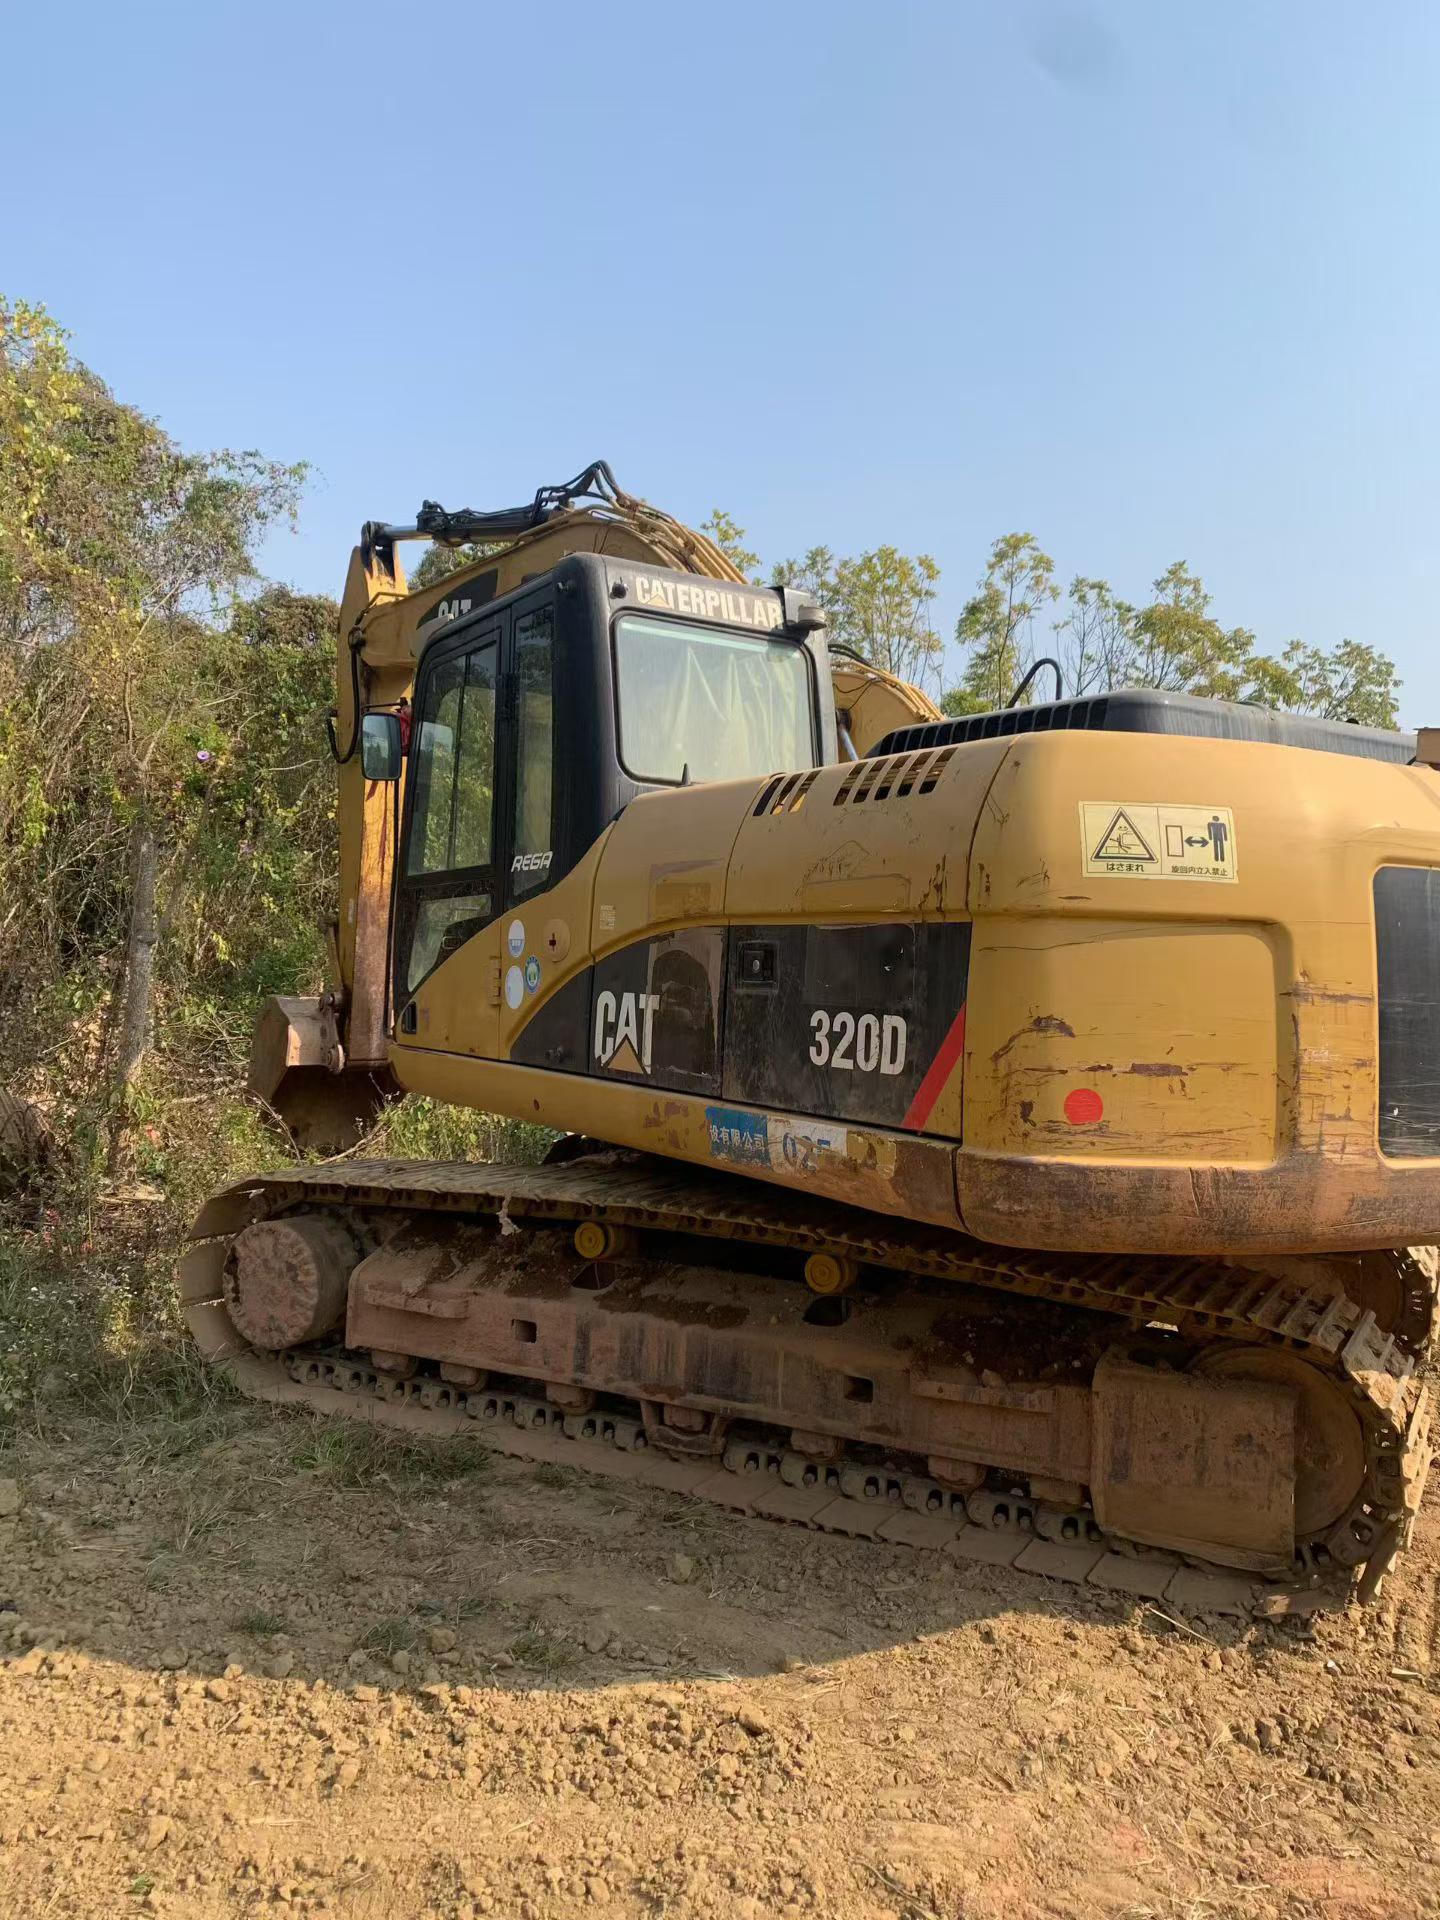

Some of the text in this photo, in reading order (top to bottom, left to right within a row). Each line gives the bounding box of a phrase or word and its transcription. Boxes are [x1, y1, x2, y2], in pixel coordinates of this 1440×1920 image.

[635, 576, 784, 629] CATERPILLAR
[511, 851, 553, 872] REGA
[1106, 863, 1145, 873] はさまれ
[1171, 865, 1228, 876] 旋回内立入禁止
[595, 991, 660, 1075] CAT
[809, 1010, 907, 1075] 320D
